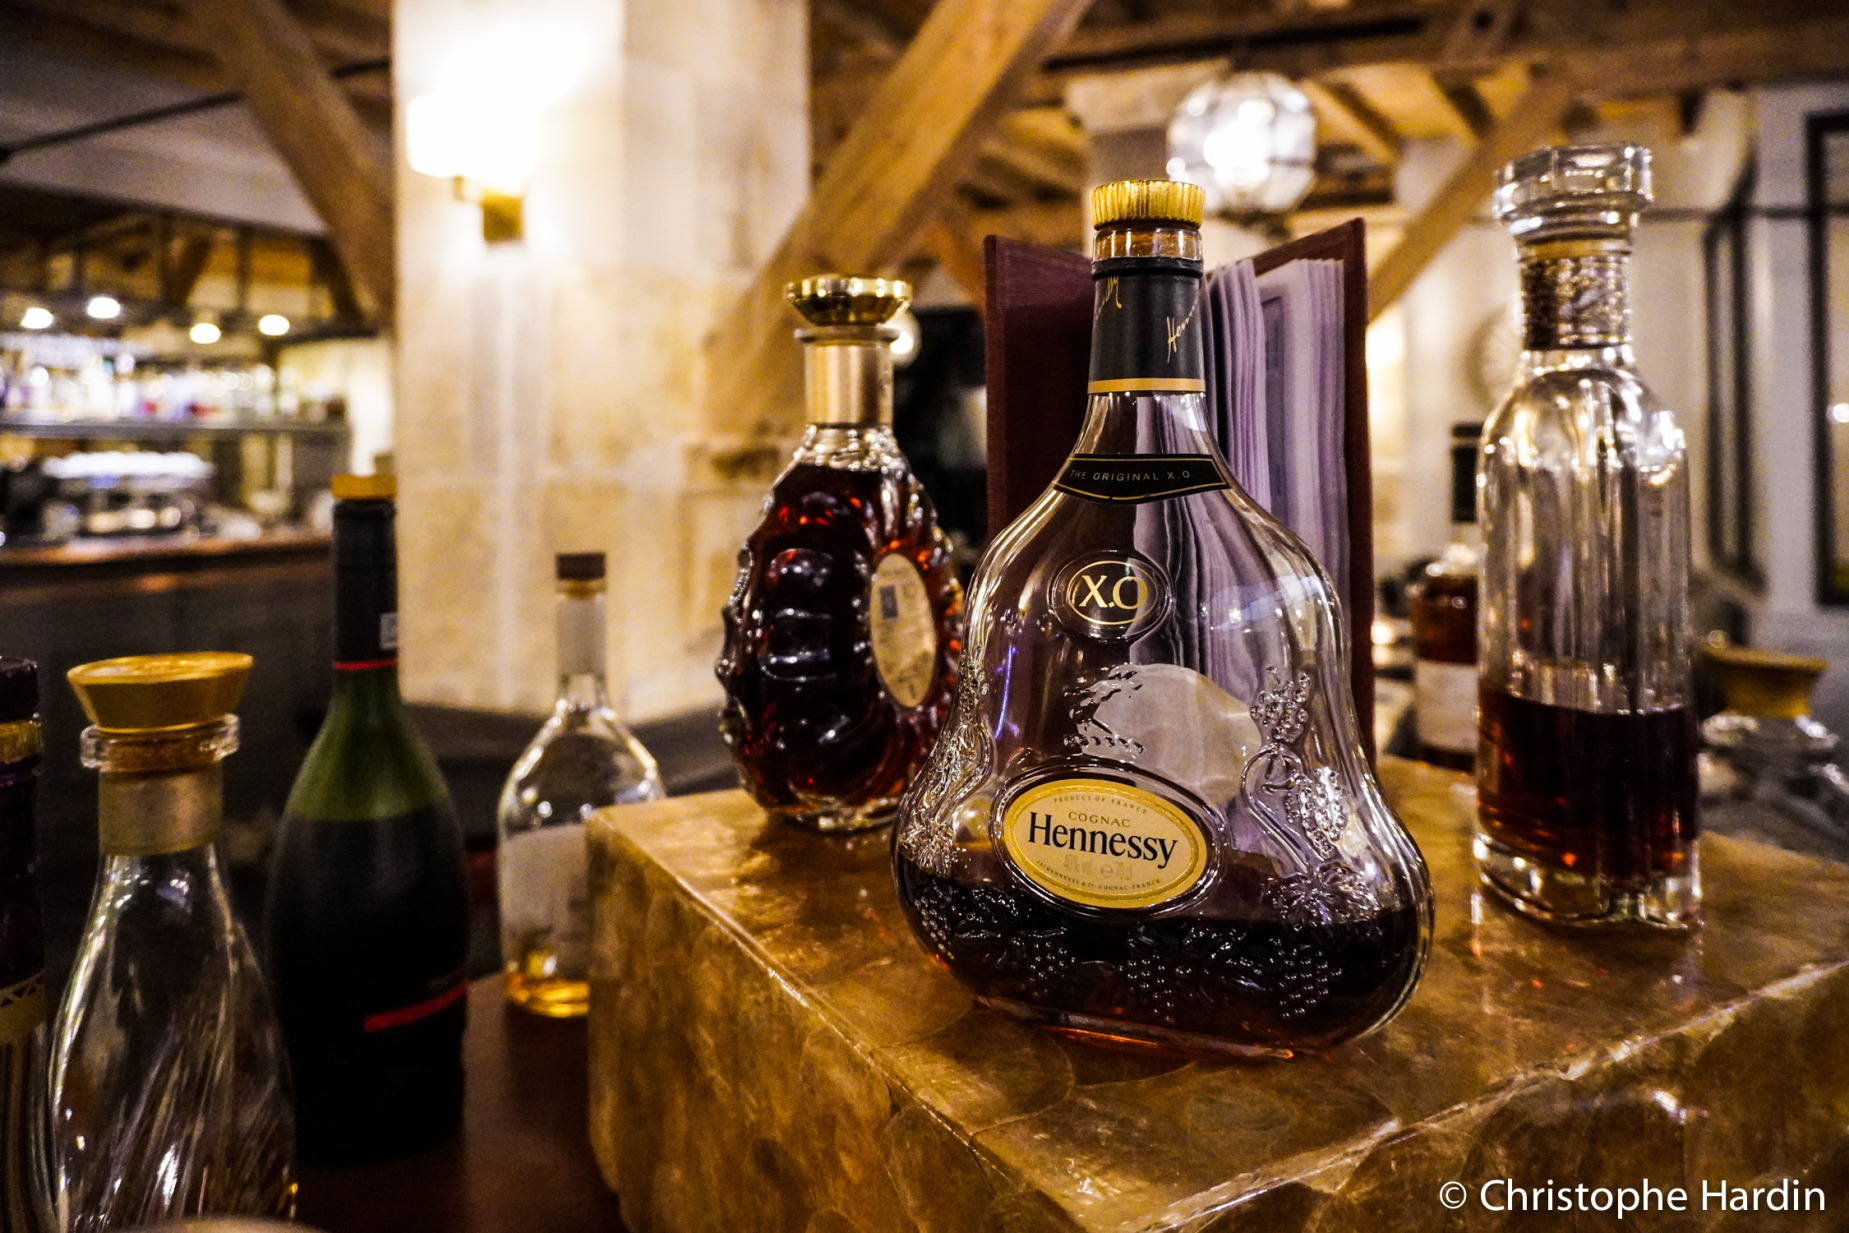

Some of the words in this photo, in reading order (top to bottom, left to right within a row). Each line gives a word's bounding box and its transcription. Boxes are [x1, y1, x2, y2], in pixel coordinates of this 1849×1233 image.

[1070, 469, 1087, 480] THE
[1092, 472, 1159, 482] ORIGINAL
[1078, 575, 1149, 610] X.O
[1053, 795, 1092, 804] PRODUCT
[1110, 799, 1148, 815] FRANCE
[1068, 811, 1131, 828] COGNAC
[1028, 811, 1178, 869] Hennessy
